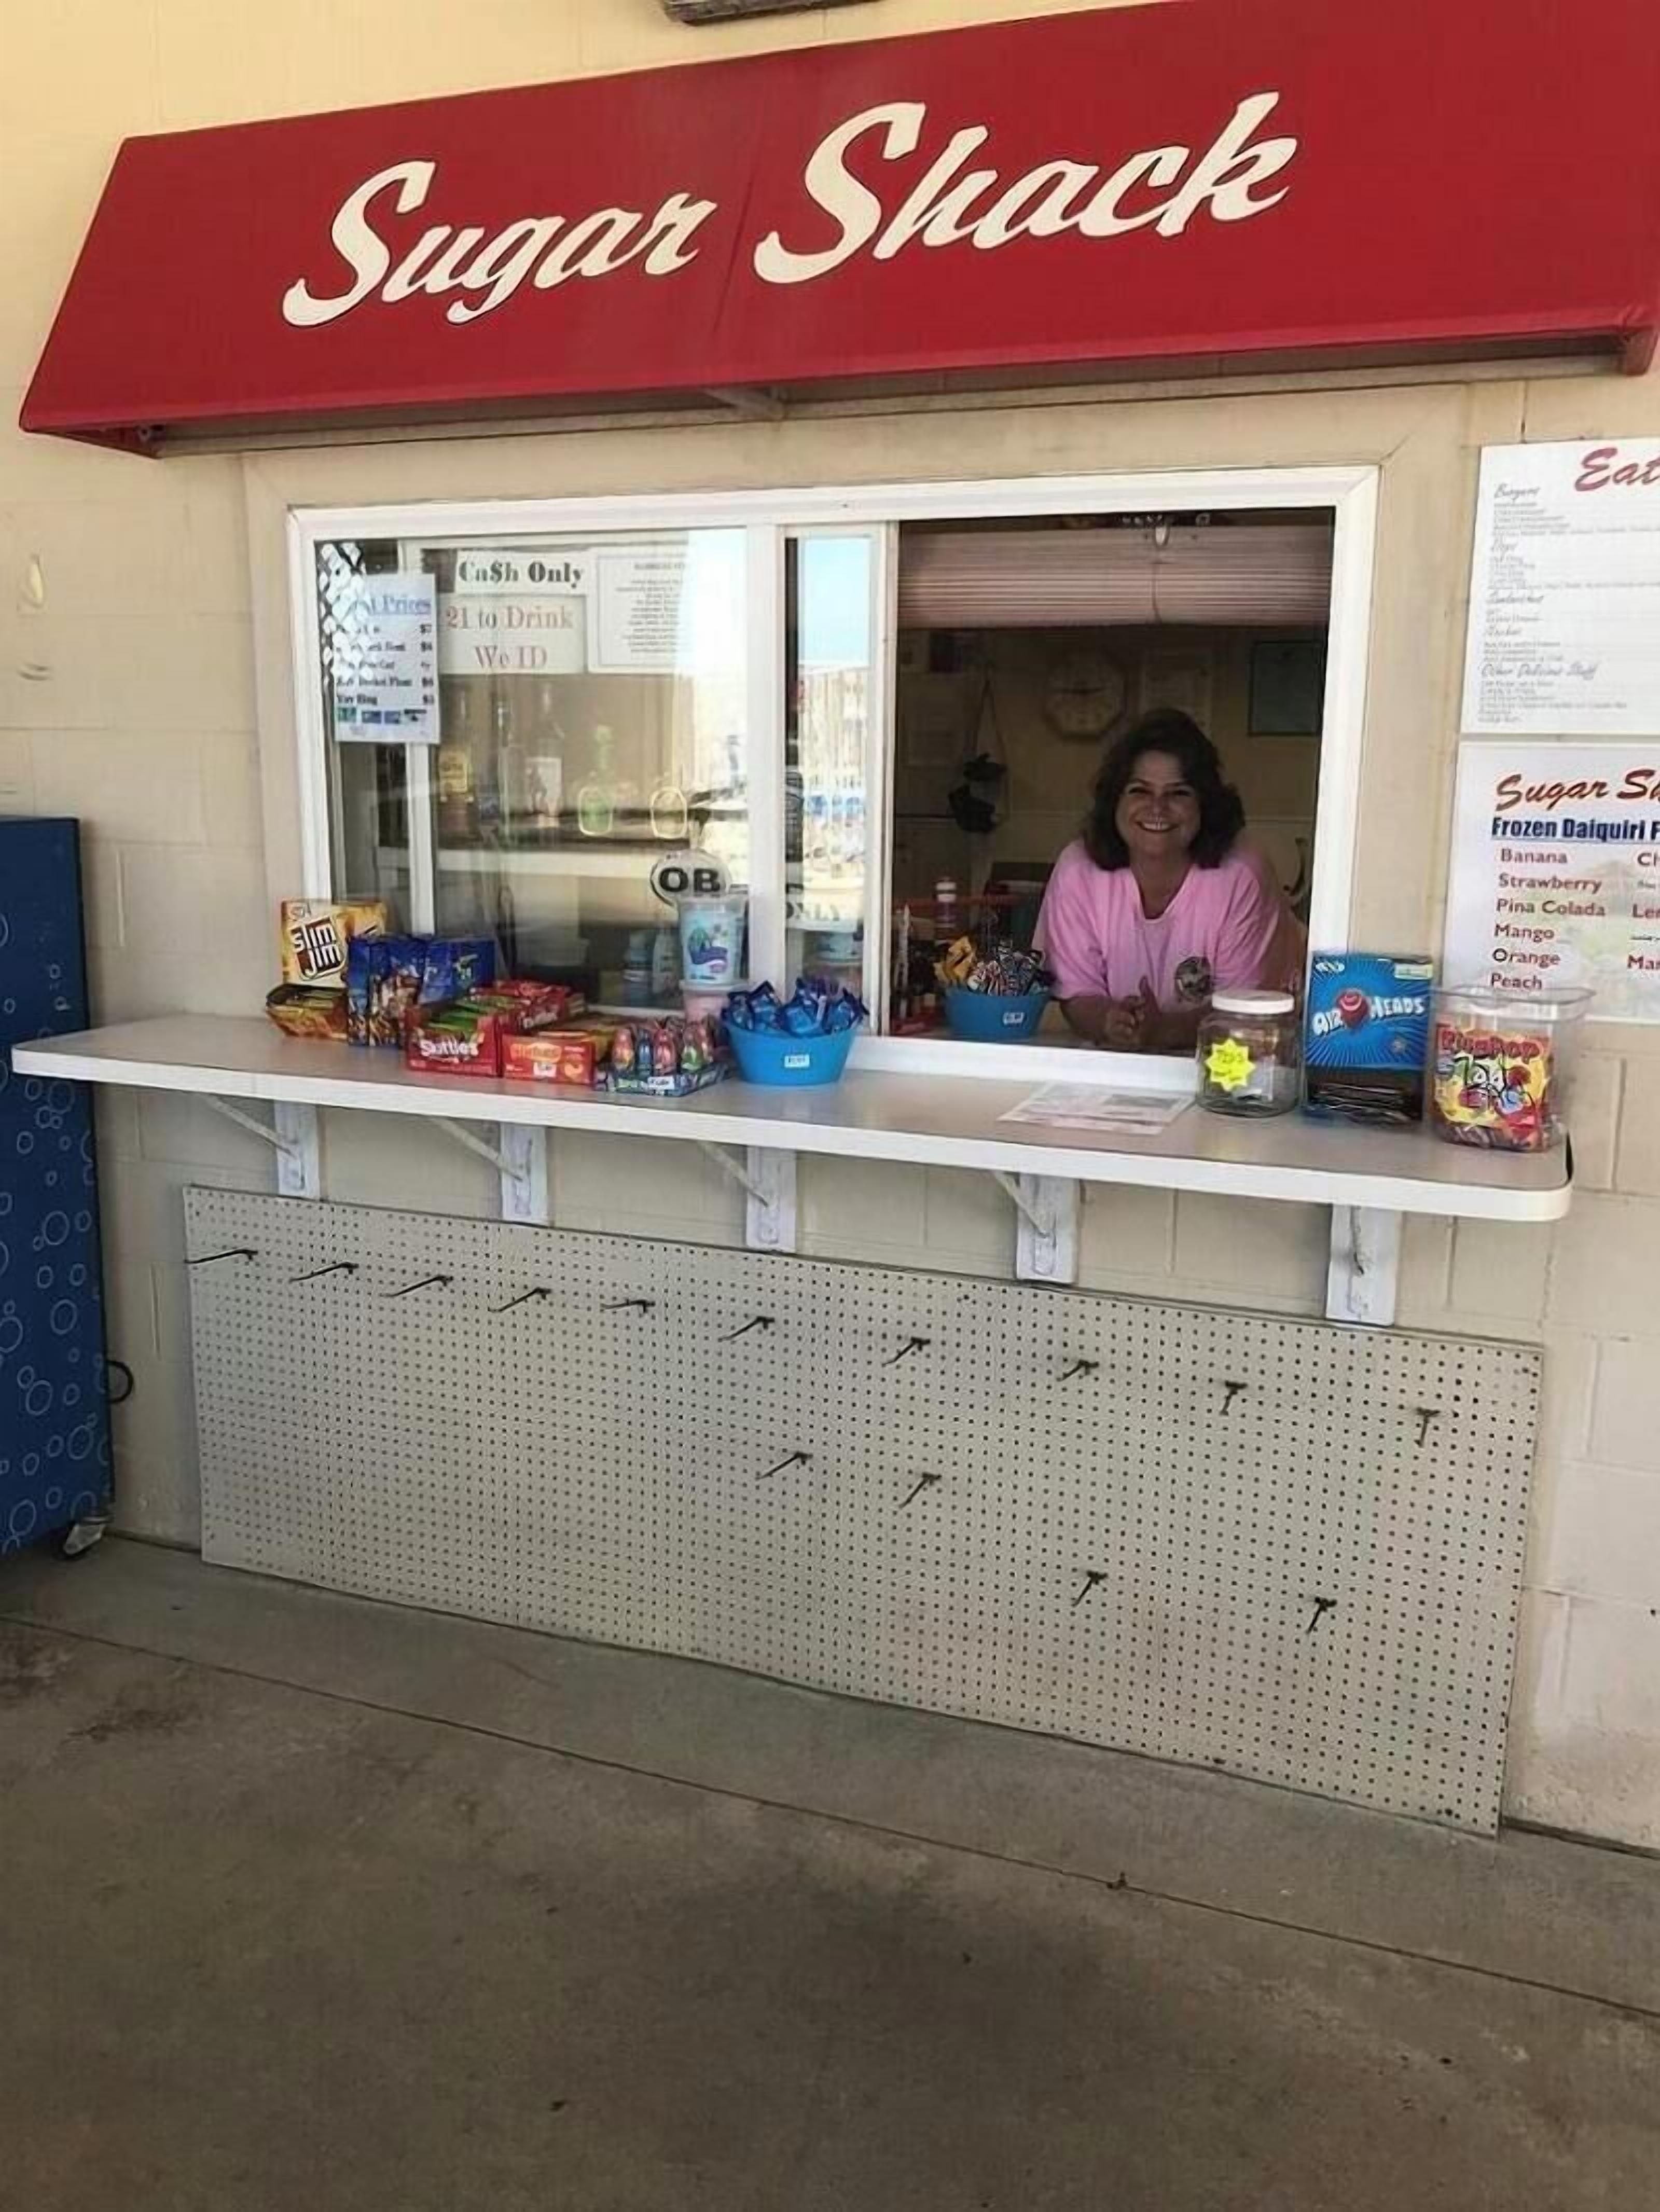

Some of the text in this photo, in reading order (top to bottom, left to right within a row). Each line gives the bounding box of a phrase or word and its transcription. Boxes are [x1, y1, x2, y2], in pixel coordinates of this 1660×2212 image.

[283, 91, 1297, 326] Sugar Shack
[459, 560, 583, 589] Ca$h Only
[446, 605, 573, 629] 21 to Drink
[473, 645, 548, 668] We ID
[1495, 774, 1609, 811] Sugar
[1492, 817, 1557, 838] Frozen
[1562, 819, 1645, 842] Daiquiri
[1501, 848, 1568, 864] Banana
[1498, 872, 1602, 894] Strawberry
[1496, 898, 1606, 917] Pina Colada
[1494, 923, 1555, 943] Mango
[1492, 948, 1561, 969] Orange
[1491, 973, 1542, 990] Peach
